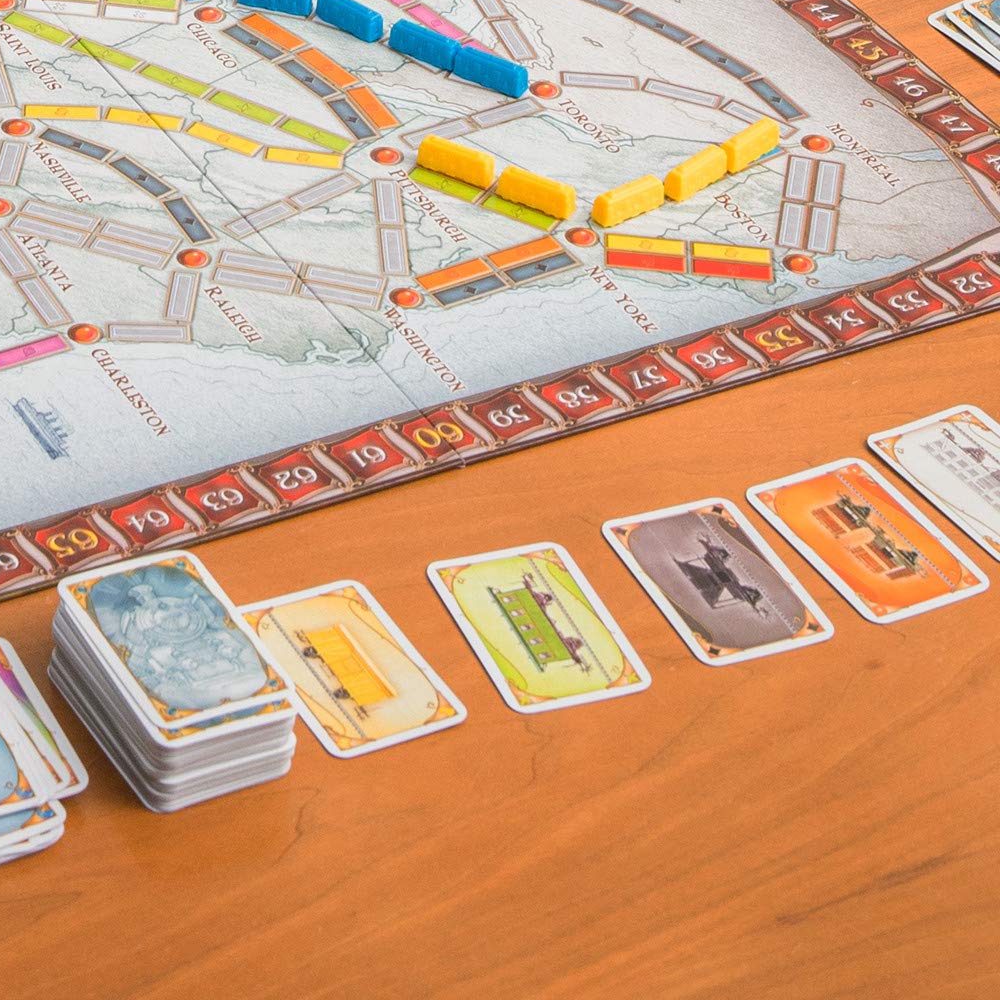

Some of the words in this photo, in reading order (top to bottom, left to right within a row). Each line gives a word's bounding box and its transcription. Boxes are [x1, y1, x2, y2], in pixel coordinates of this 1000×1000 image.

[809, 1, 840, 22] 44
[186, 22, 237, 68] CHICAGO
[847, 37, 888, 61] 45
[25, 58, 62, 90] LOUIS
[893, 76, 928, 97] 46
[558, 98, 620, 154] TORONTO
[938, 114, 974, 132] 47
[28, 141, 92, 204] NASHVILLE
[389, 169, 468, 243] PITTSBURGH
[714, 192, 772, 244] BOSTON
[17, 234, 74, 292] ATLANTA
[950, 272, 993, 294] 52
[584, 266, 618, 291] NEW
[615, 293, 658, 334] YORK
[888, 290, 930, 312] 53
[204, 286, 262, 344] RALEIGH
[824, 308, 865, 330] 54
[384, 307, 466, 393] WASHINGTON
[756, 325, 803, 352] 55
[692, 346, 734, 369] 56
[630, 366, 668, 390] 57
[91, 348, 172, 437] CHARLESTON
[556, 384, 600, 408] 58
[488, 404, 531, 428] 59
[413, 422, 464, 448] 60
[347, 445, 386, 468] 61
[272, 466, 318, 490] 62
[202, 488, 244, 511] 63
[128, 509, 170, 532] 64
[48, 528, 98, 558] 65
